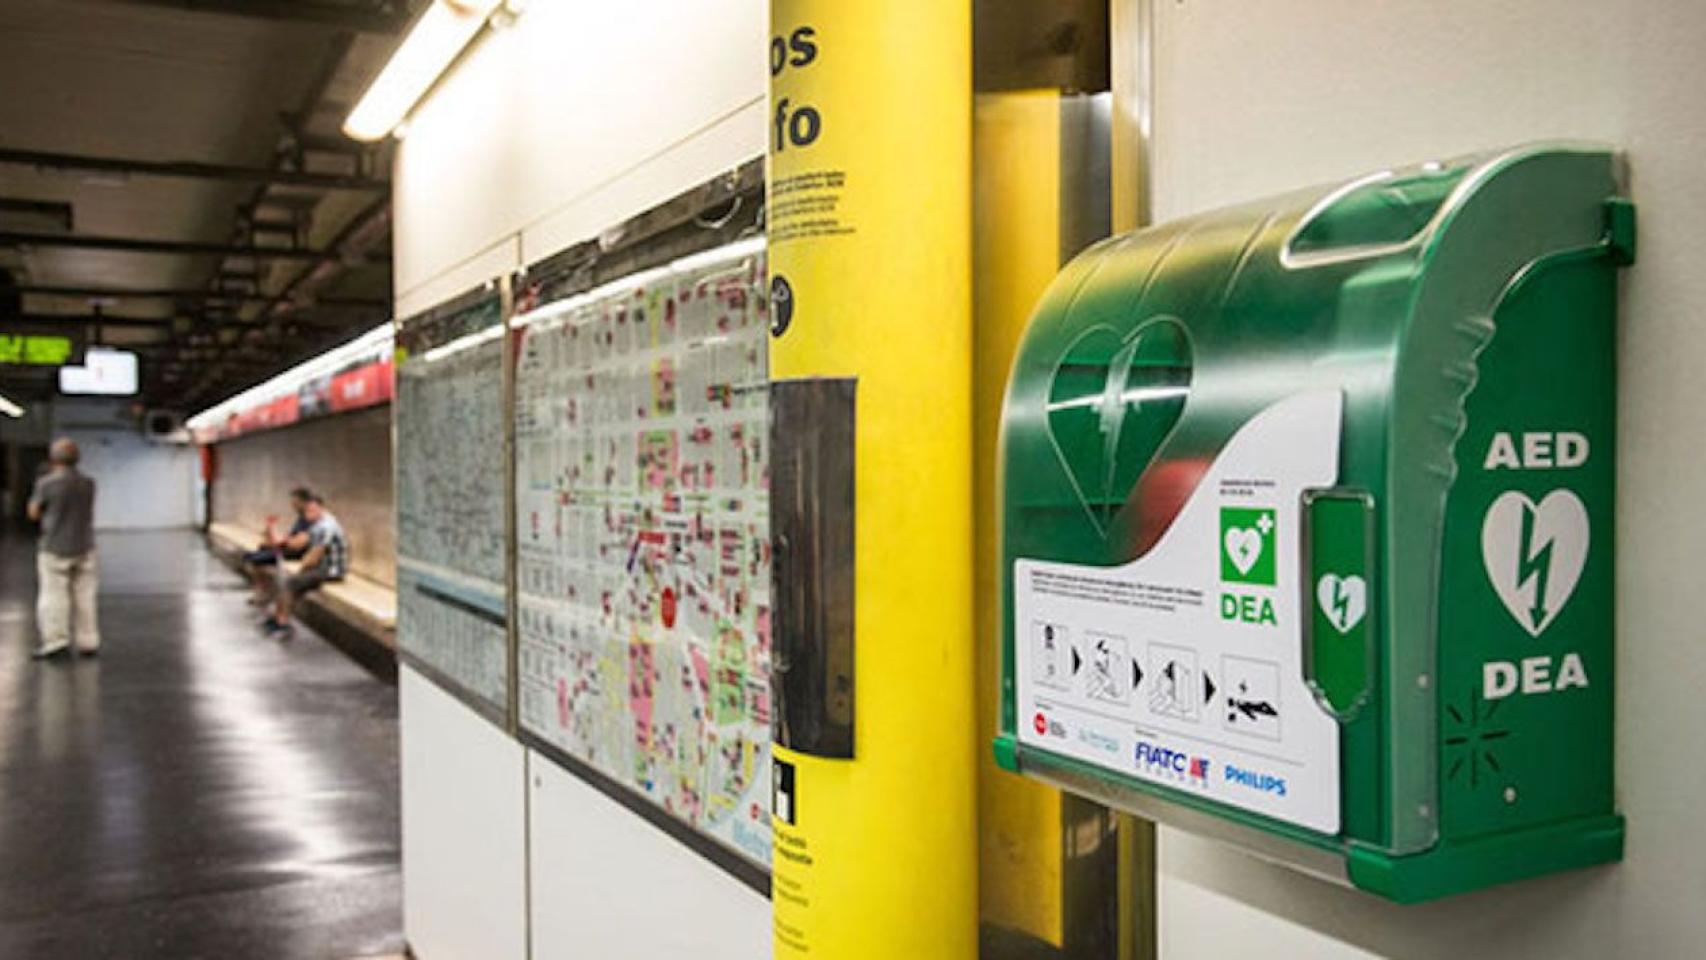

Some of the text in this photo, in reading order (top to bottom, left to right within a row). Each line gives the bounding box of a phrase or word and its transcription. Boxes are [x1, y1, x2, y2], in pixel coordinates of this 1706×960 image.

[1484, 432, 1590, 470] AED
[1220, 593, 1278, 626] DEA
[1483, 653, 1588, 699] DEA
[1225, 764, 1287, 797] PHILIPS
